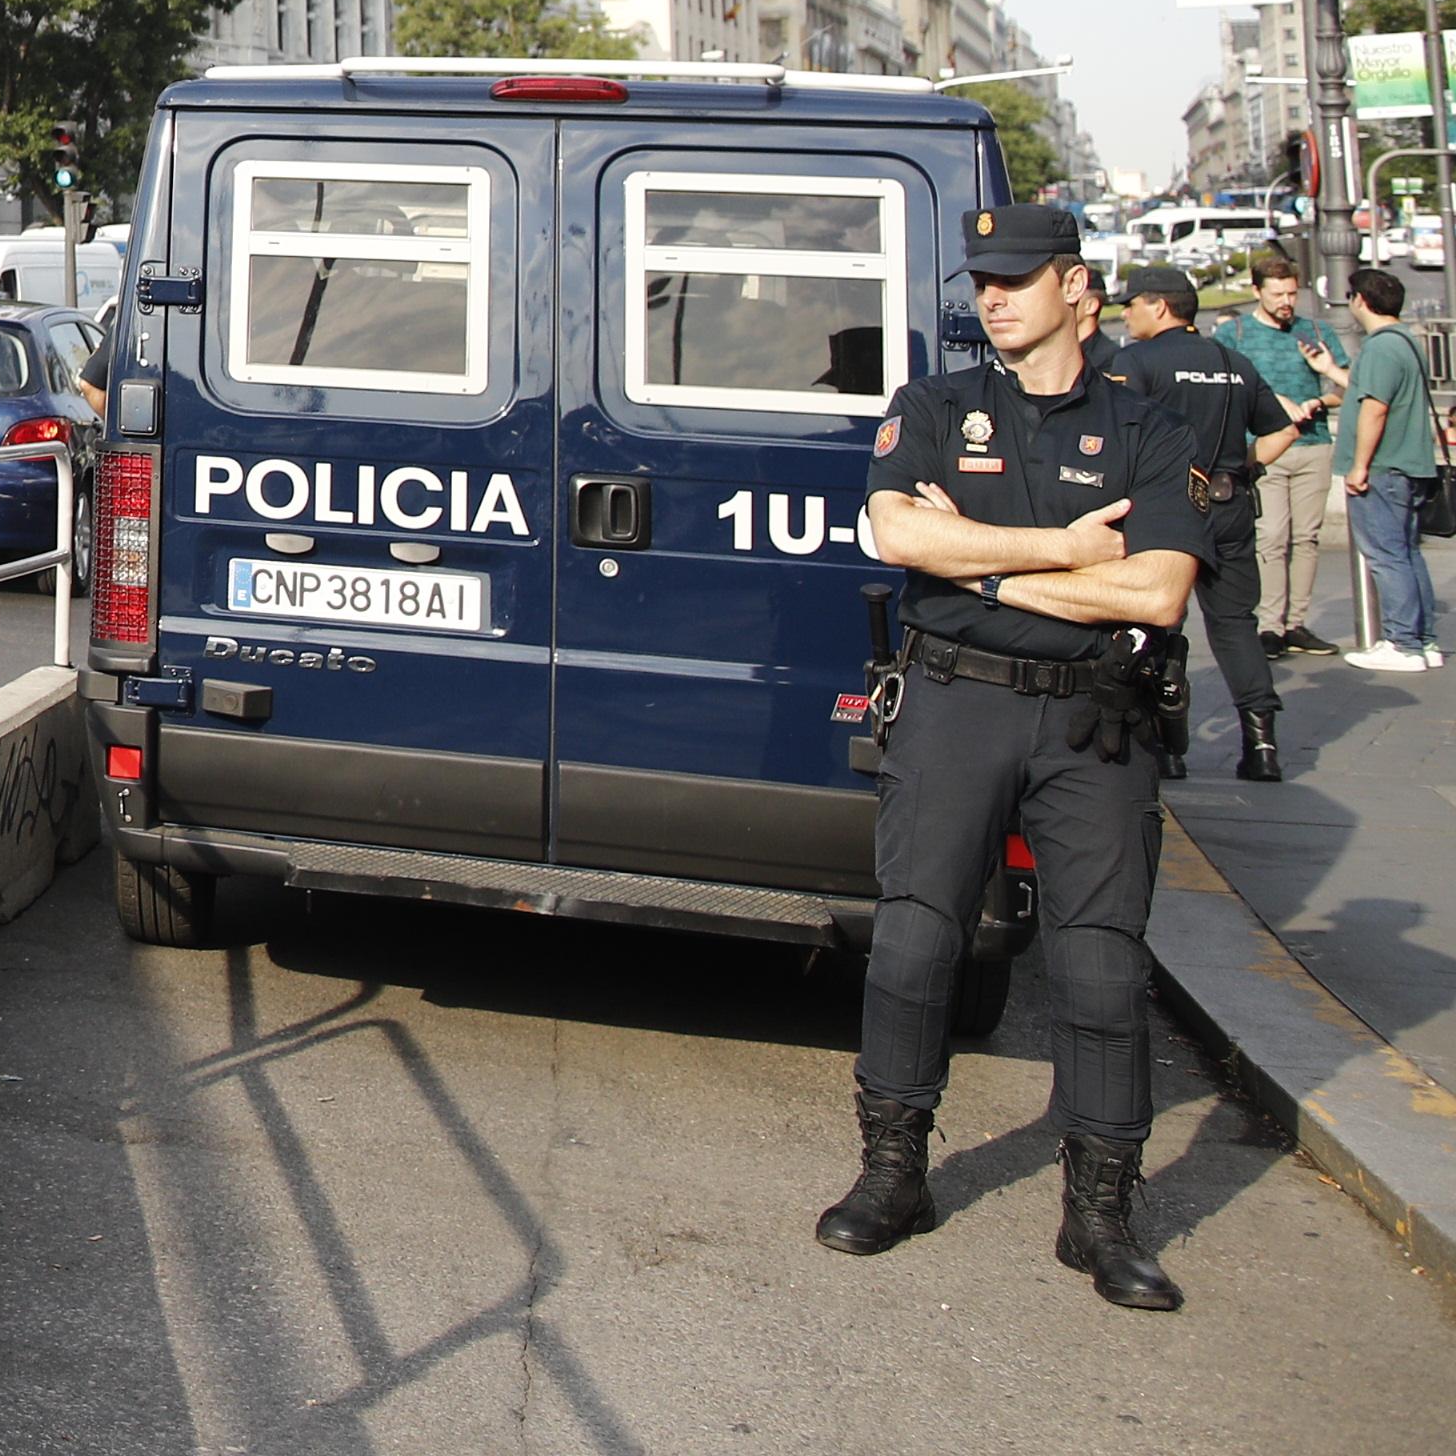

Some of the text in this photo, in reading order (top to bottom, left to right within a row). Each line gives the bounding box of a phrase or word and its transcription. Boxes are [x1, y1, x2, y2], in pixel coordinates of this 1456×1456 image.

[1174, 370, 1245, 386] POLICIA
[194, 454, 531, 537] POLICIA
[251, 567, 465, 622] CNP3818AI
[203, 635, 377, 674] Ducato
